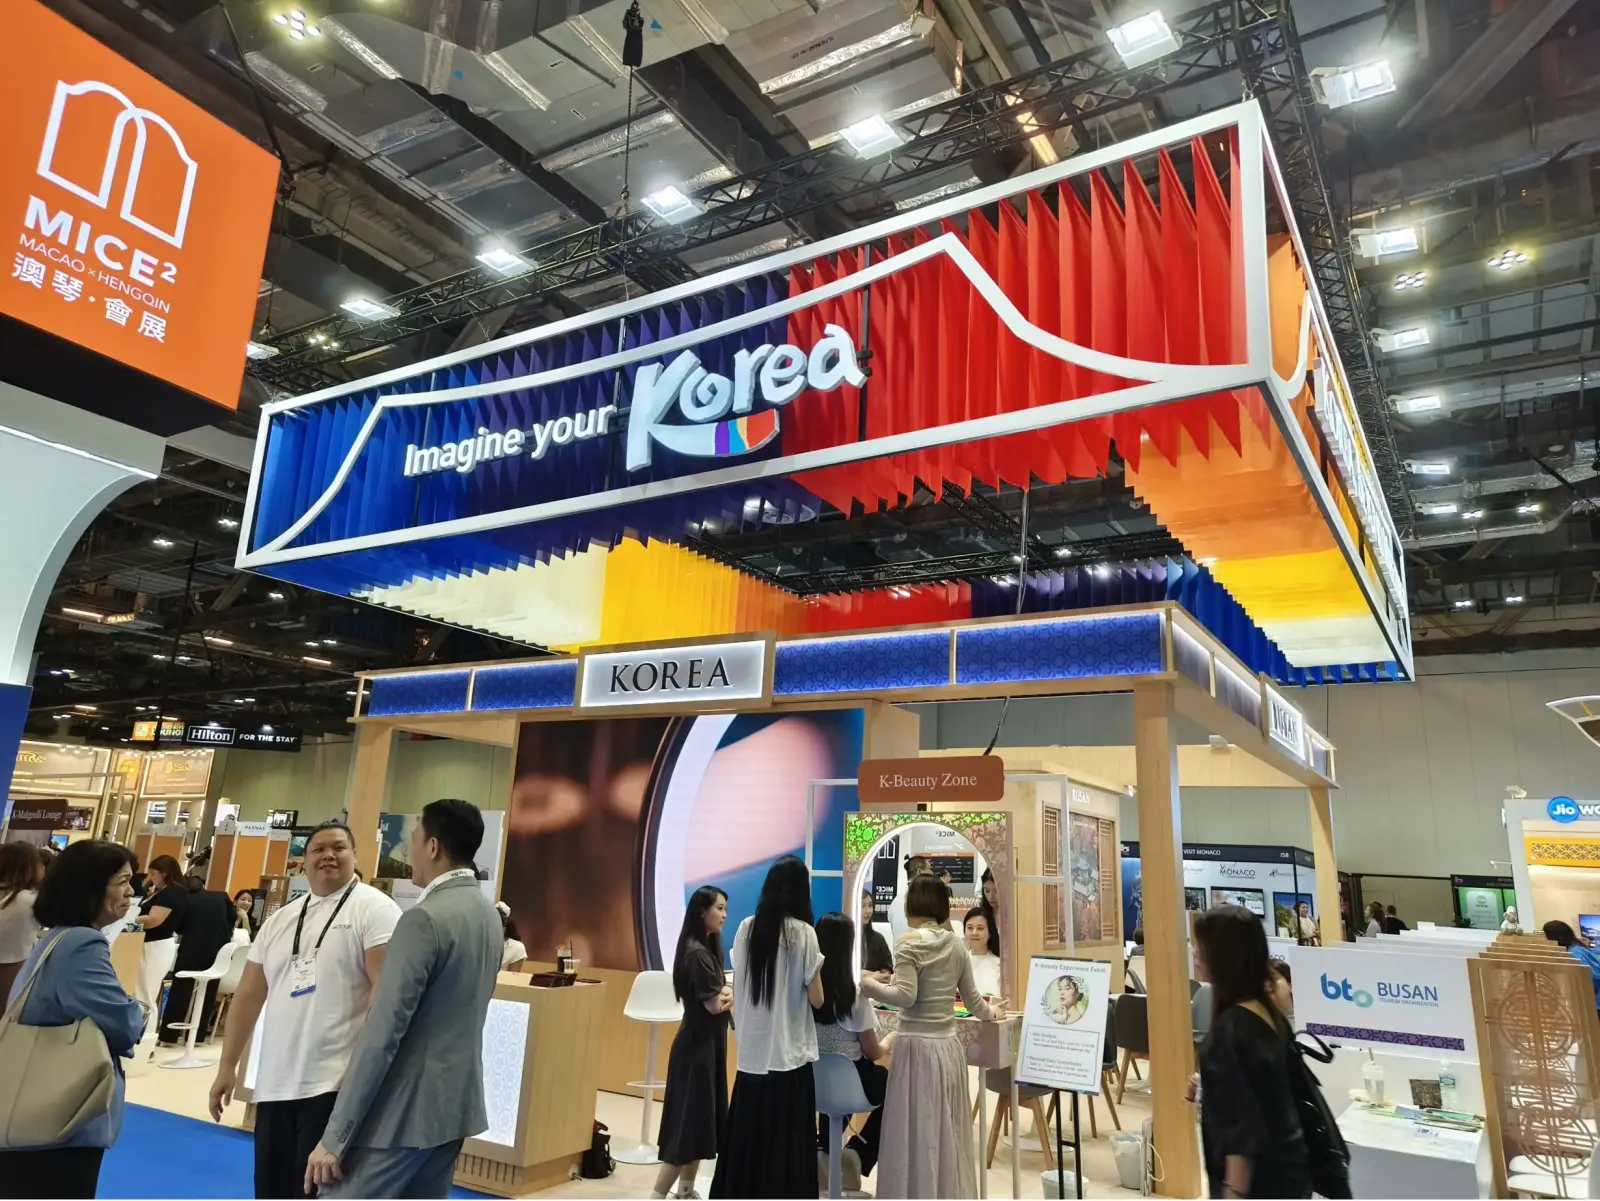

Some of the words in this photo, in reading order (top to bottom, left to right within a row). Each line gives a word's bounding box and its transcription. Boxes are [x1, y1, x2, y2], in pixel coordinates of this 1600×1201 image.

[19, 233, 85, 273] MACAO
[98, 272, 171, 314] HENGQIN
[403, 427, 523, 476] Imagine
[531, 404, 618, 460] your
[626, 323, 869, 472] Korea
[609, 656, 731, 693] KOREA
[191, 729, 230, 741] Hilton
[239, 733, 255, 741] FOR
[258, 734, 273, 742] THE
[879, 774, 938, 790] K-Beauty
[941, 773, 977, 786] Zone
[1552, 803, 1576, 815] Jio
[1219, 868, 1256, 877] MONACO
[1060, 964, 1089, 972] Experience
[1320, 973, 1374, 1008] bto
[1377, 982, 1438, 1001] BUSAN
[1401, 999, 1439, 1008] ORGANIZATION
